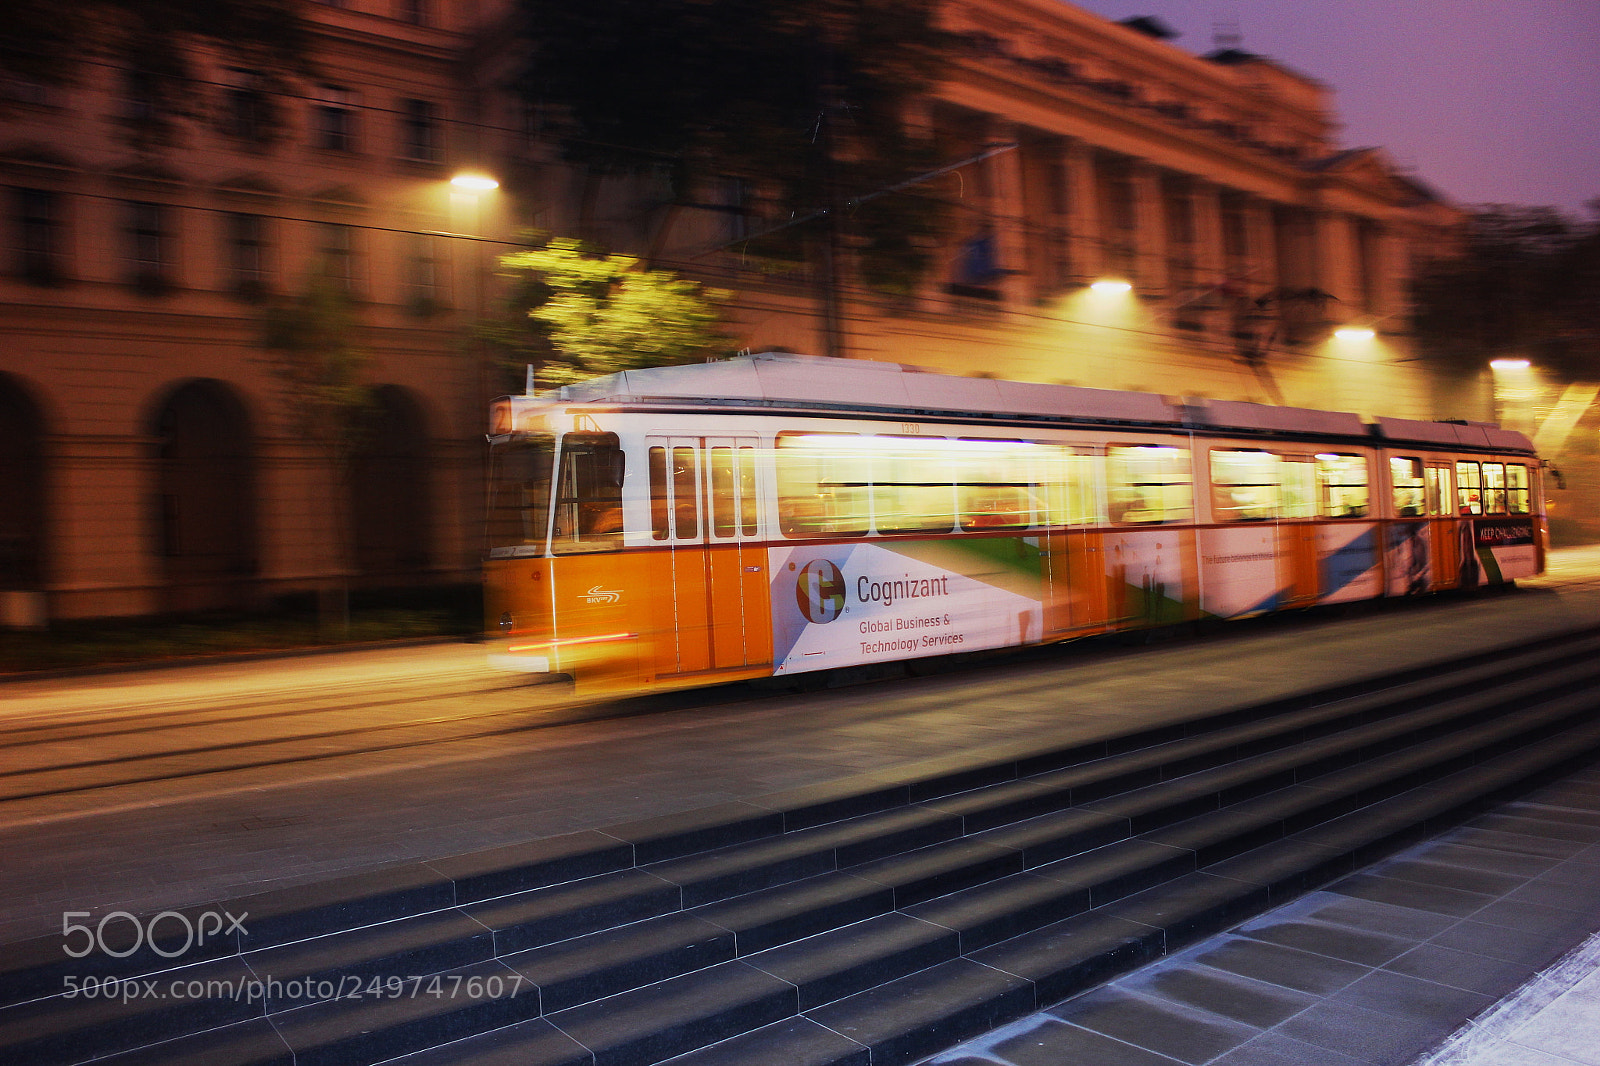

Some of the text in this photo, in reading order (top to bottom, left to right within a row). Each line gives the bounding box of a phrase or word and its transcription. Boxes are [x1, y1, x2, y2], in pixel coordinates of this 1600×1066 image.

[495, 405, 506, 433] 2
[901, 424, 920, 434] 1330
[1480, 528, 1495, 540] KEEP
[858, 574, 949, 606] Cognizant
[859, 613, 950, 634] Global Business &
[860, 632, 964, 655] Technology Services
